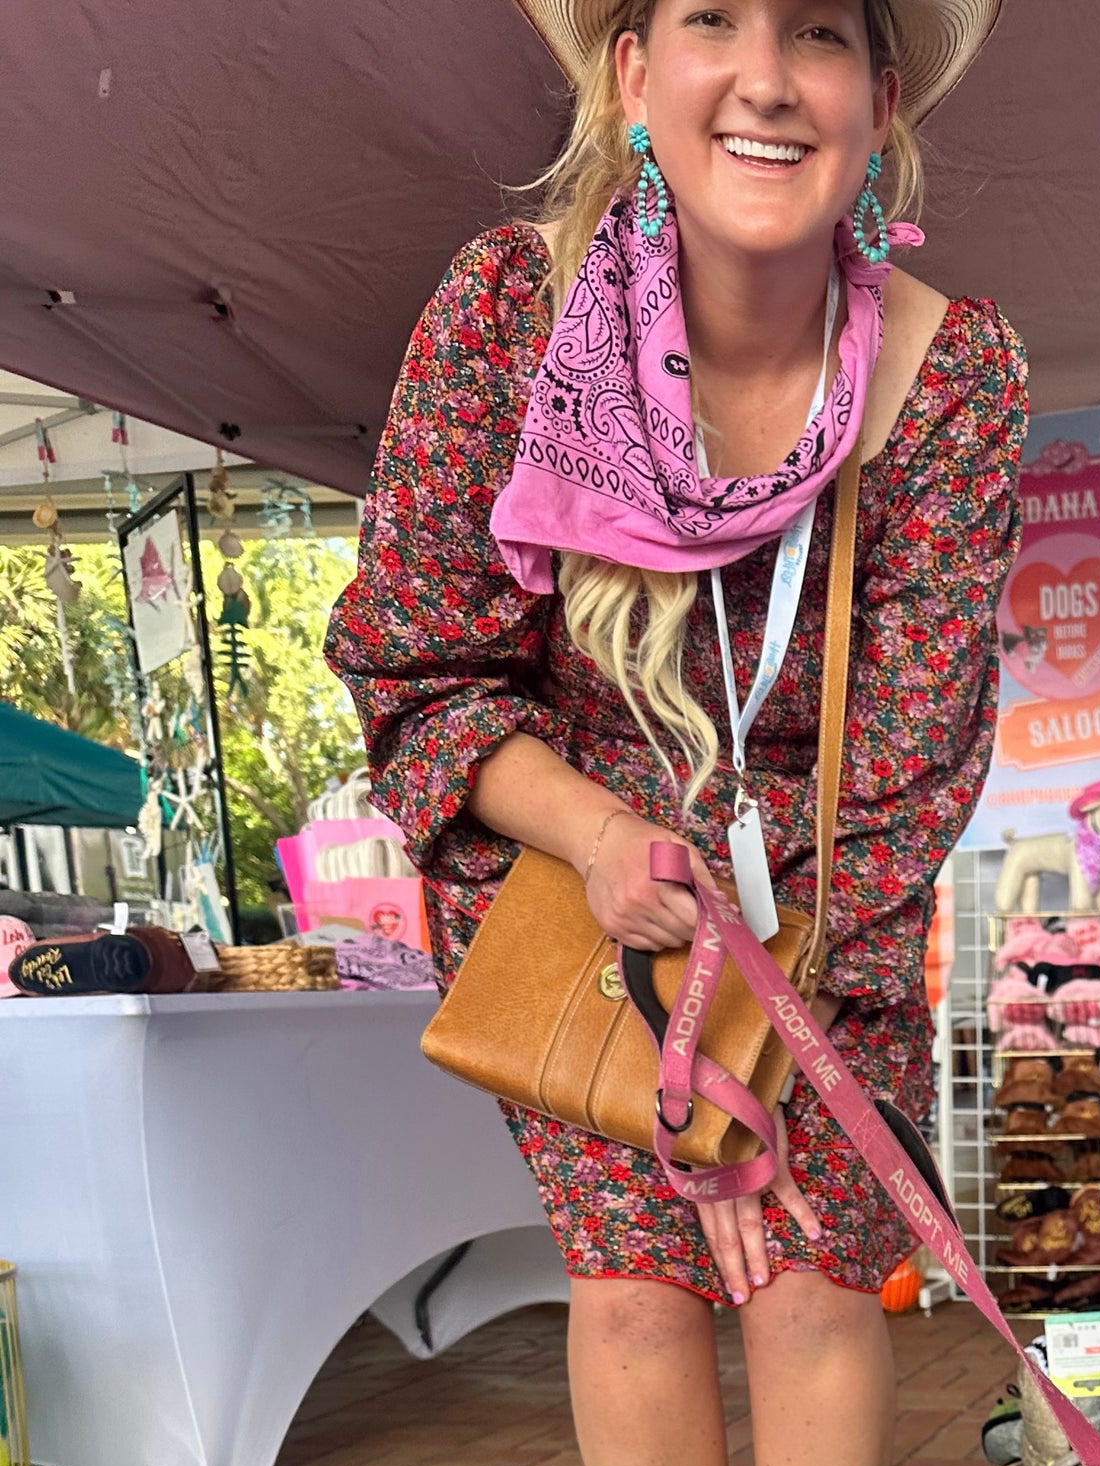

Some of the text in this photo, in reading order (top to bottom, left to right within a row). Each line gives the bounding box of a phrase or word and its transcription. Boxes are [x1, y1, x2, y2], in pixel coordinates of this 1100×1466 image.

[1022, 488, 1099, 524] DANA
[1039, 582, 1099, 621] DOGS
[672, 914, 722, 1056] ADOPT M
[769, 994, 843, 1092] ADOPT ME
[682, 1176, 720, 1196] ME
[888, 1167, 969, 1285] ADOPT ME
